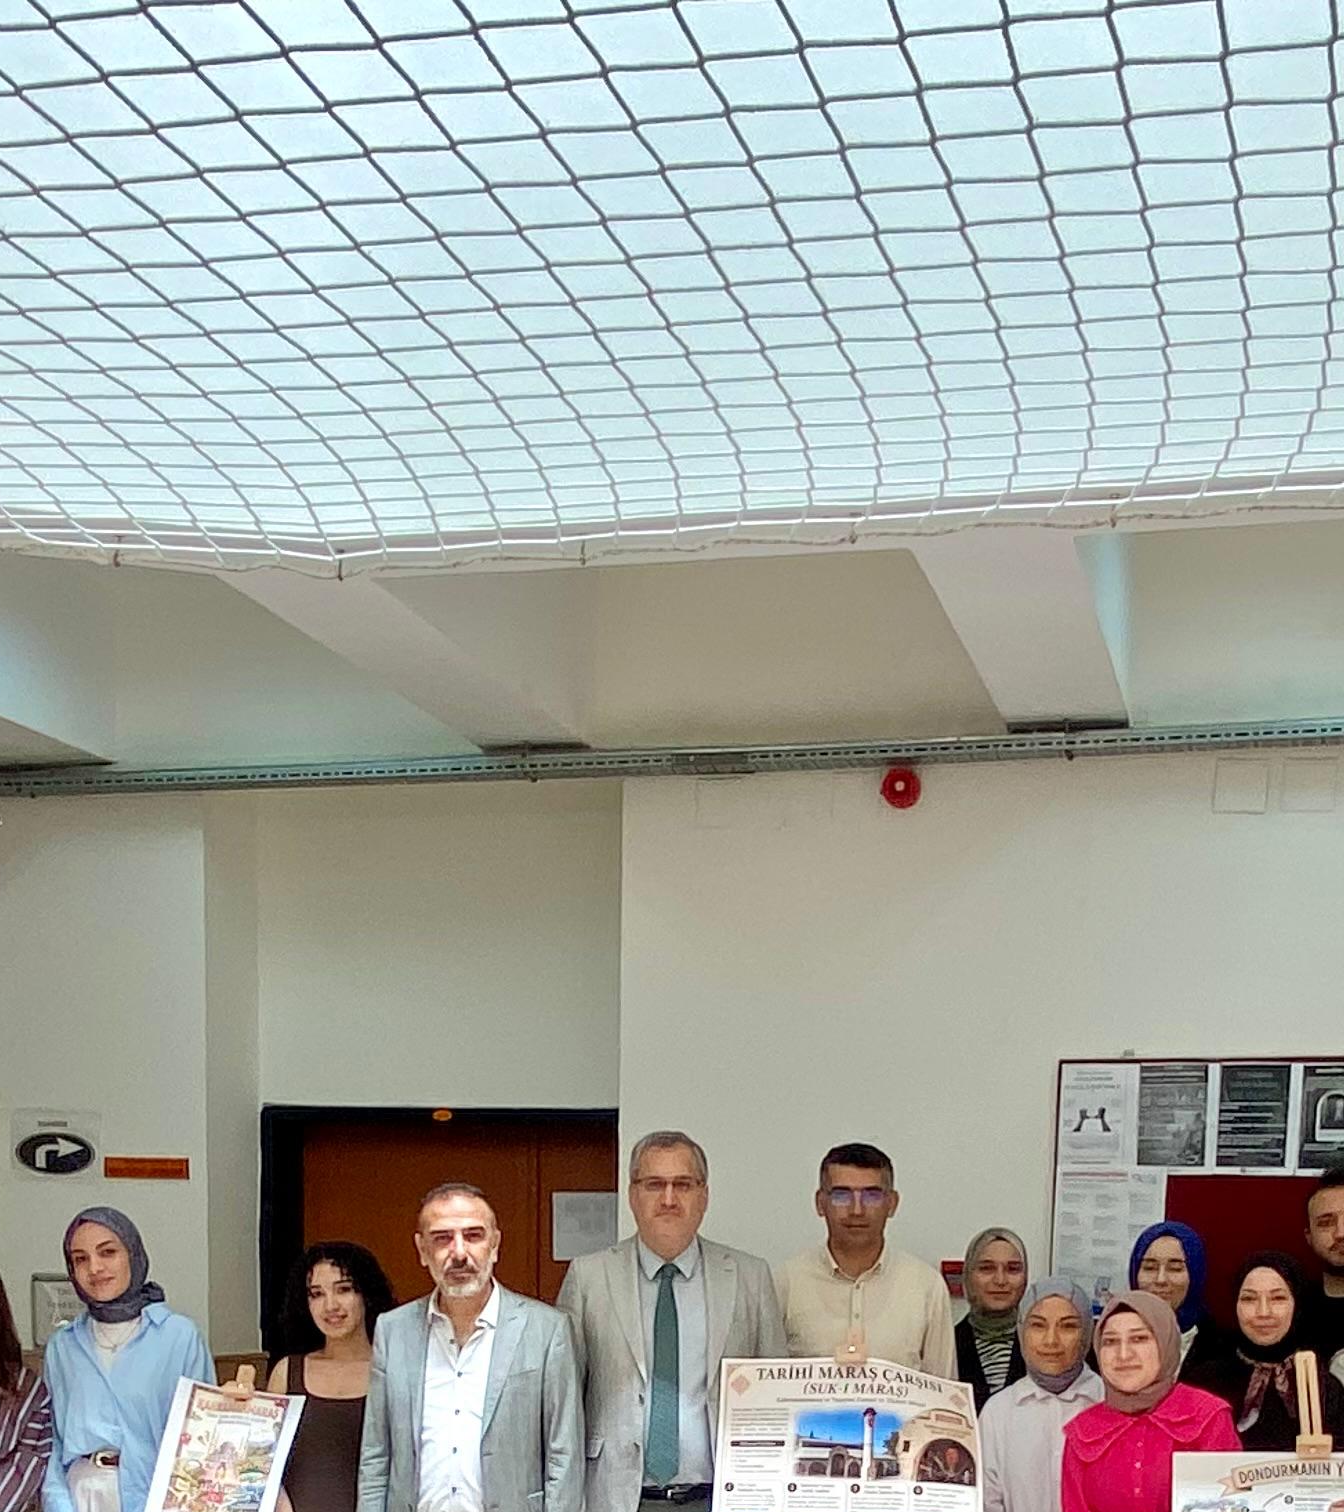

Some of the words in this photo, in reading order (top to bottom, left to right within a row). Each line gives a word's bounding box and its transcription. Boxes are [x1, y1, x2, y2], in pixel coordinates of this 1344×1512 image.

[756, 1364, 813, 1381] TARİHİ
[818, 1366, 878, 1383] MARAŞ
[882, 1367, 944, 1394] ÇARŞISI
[1238, 1462, 1331, 1484] DONDURMANIN
